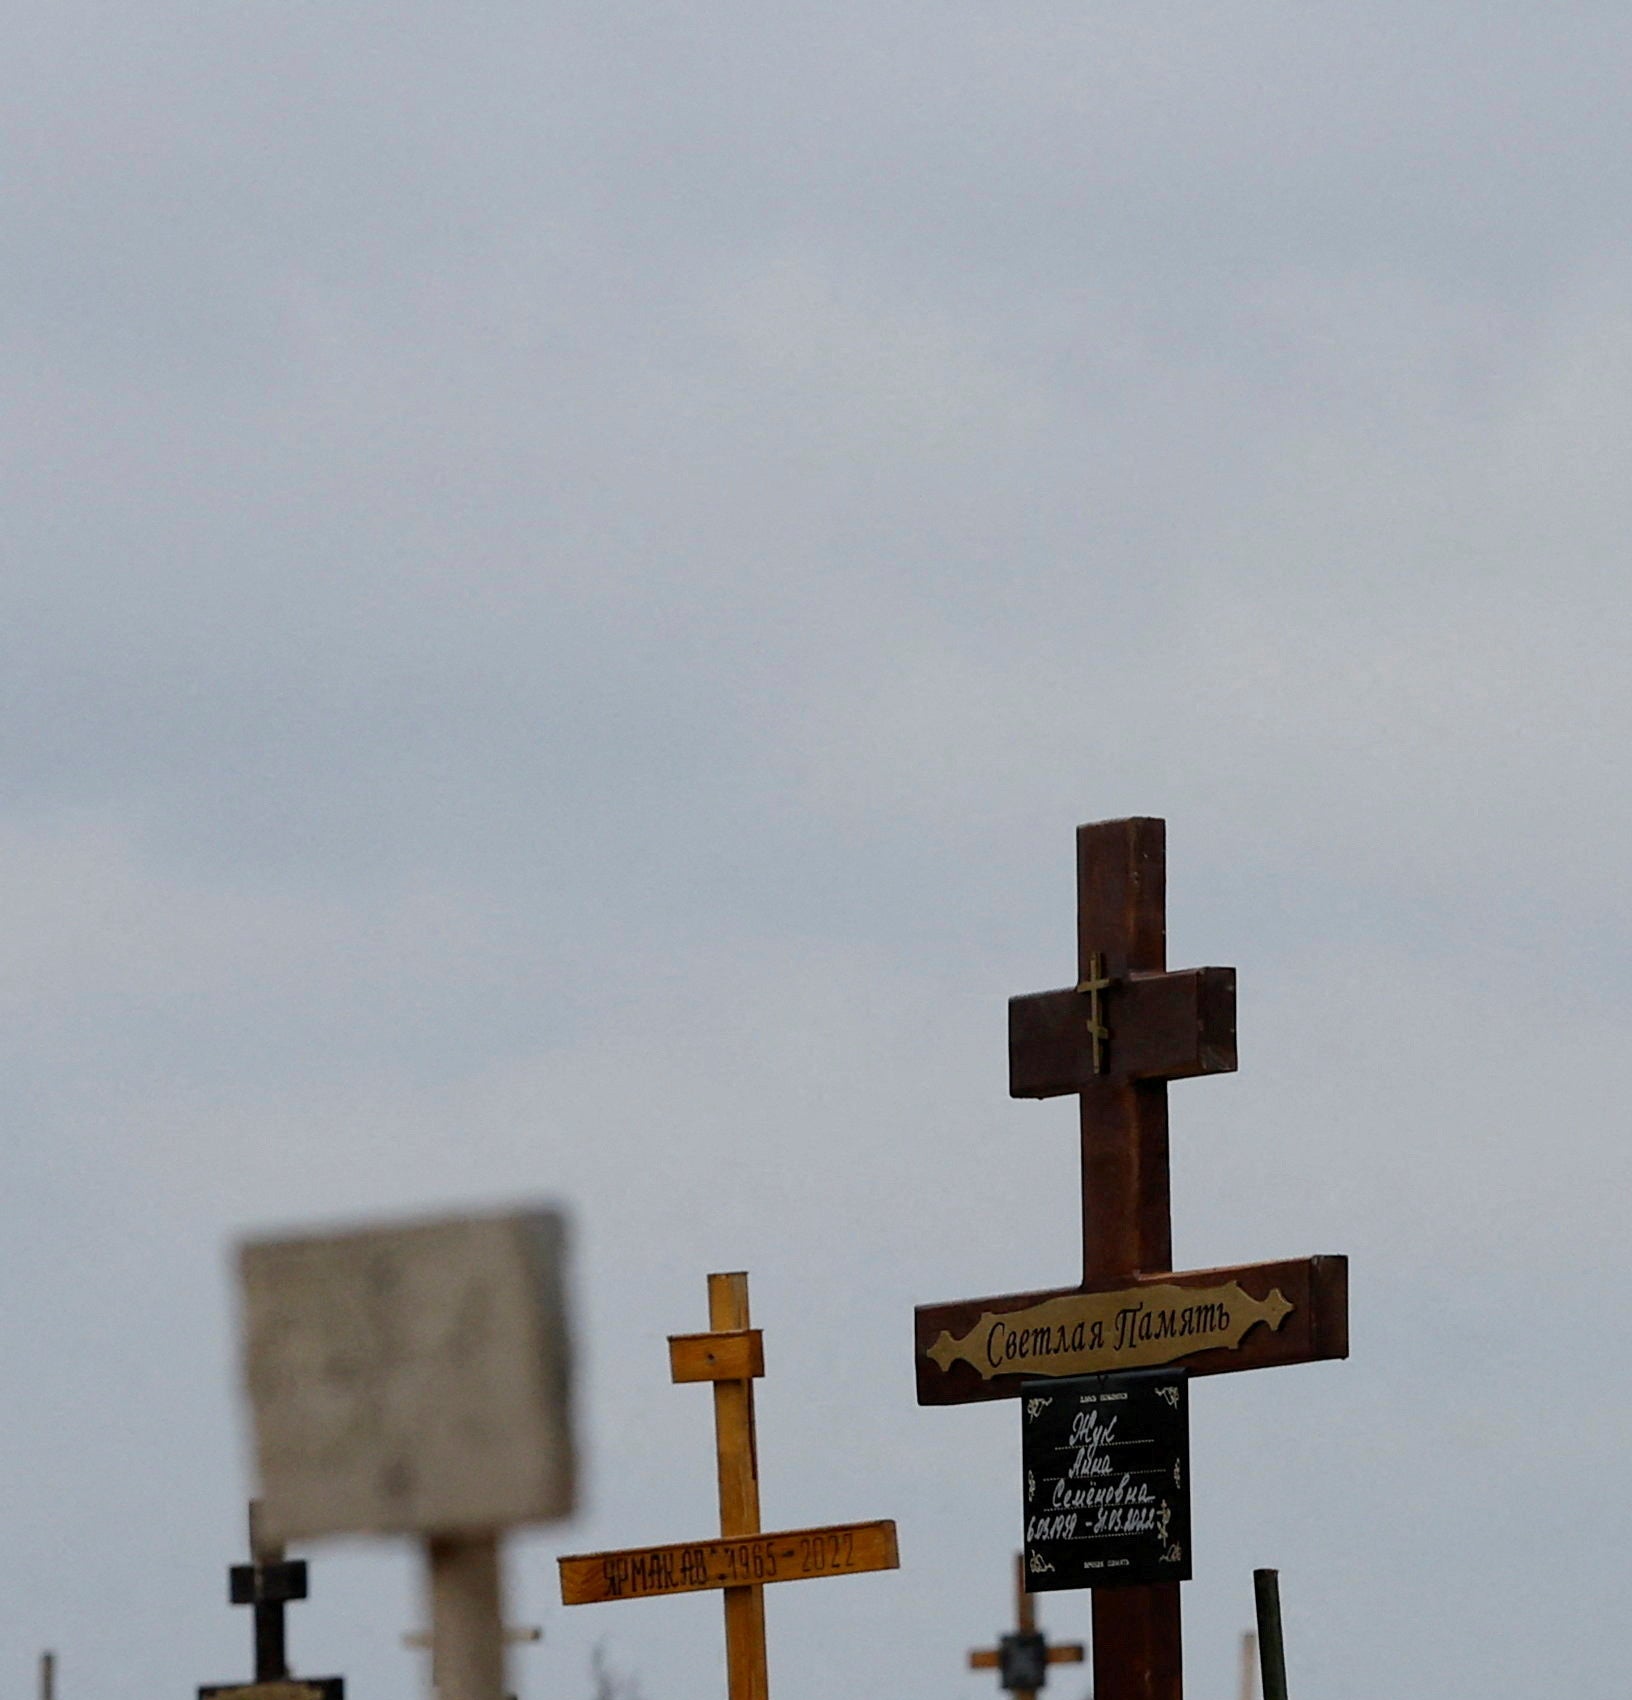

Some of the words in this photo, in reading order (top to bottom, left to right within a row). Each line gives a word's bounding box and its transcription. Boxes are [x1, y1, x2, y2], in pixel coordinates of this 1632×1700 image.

[985, 1320, 1105, 1369] Светлая
[1112, 1301, 1231, 1352] Память
[1069, 1410, 1116, 1456] Жук
[1051, 1473, 1157, 1509] Семёновна
[602, 1551, 679, 1597] ЯРМАК
[725, 1541, 777, 1581] 1965
[799, 1532, 855, 1573] 2022
